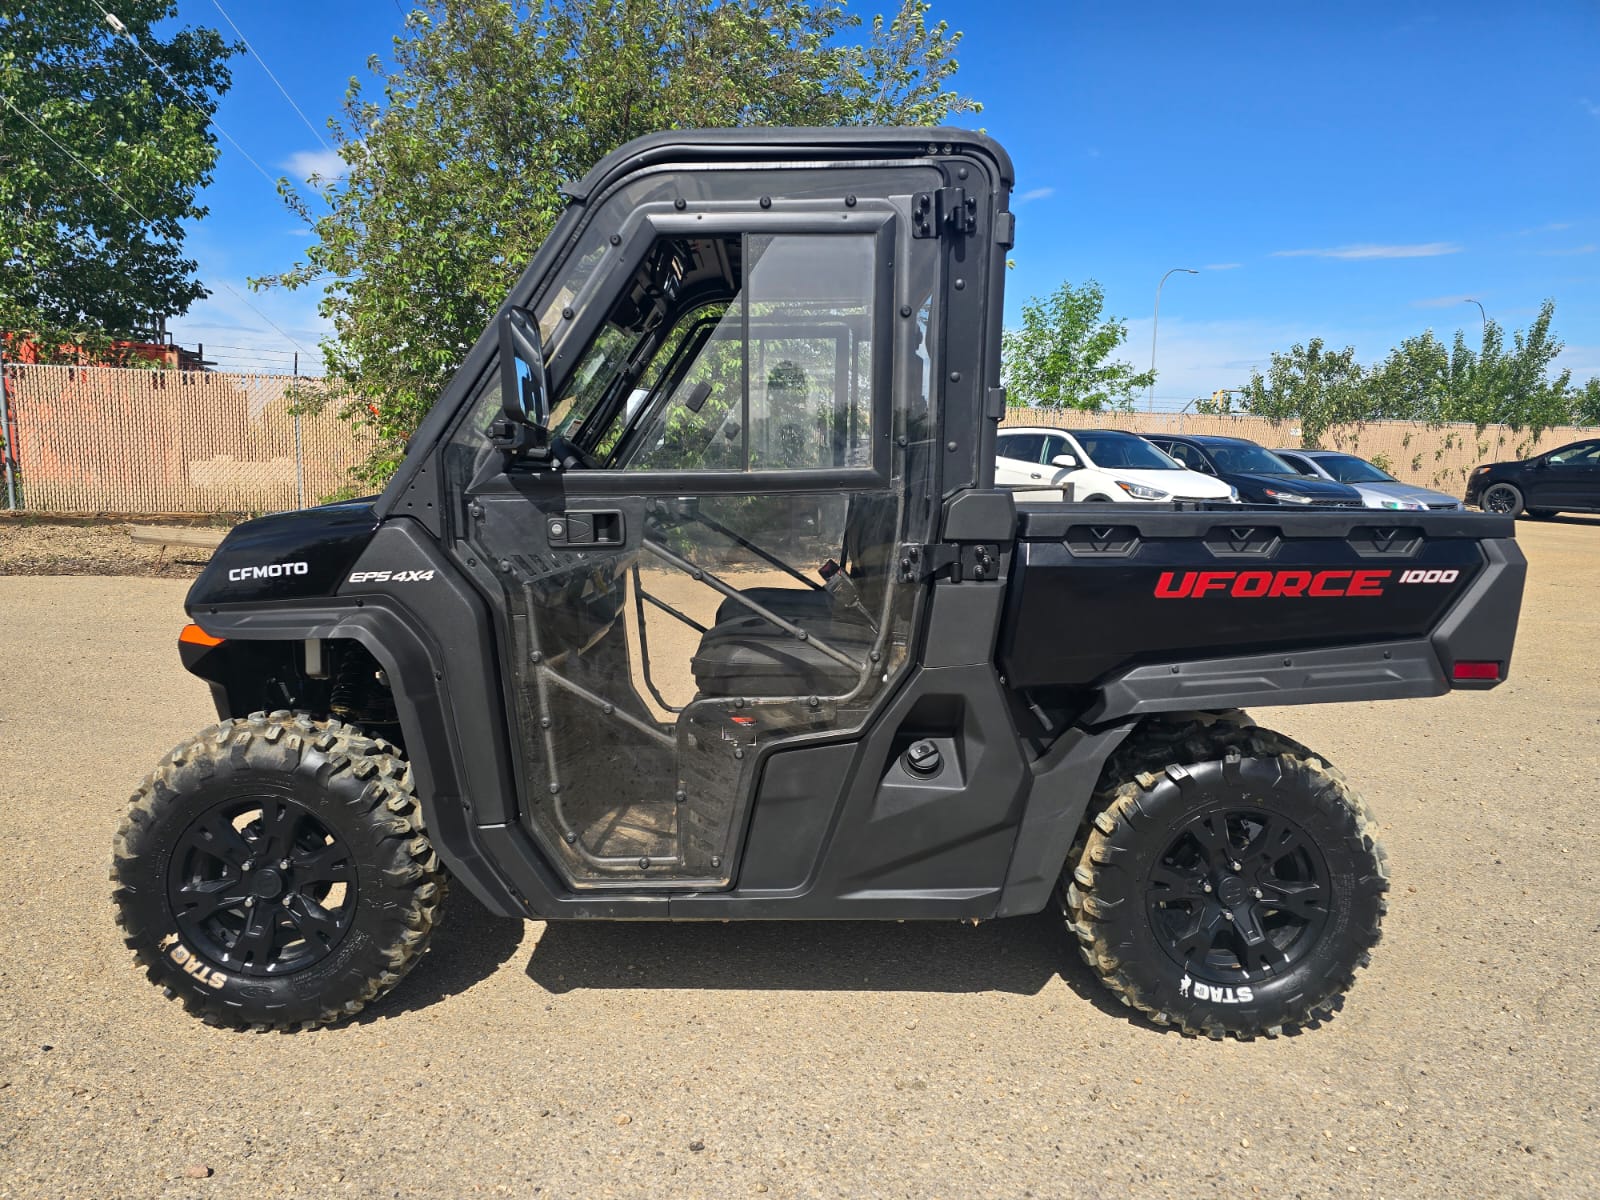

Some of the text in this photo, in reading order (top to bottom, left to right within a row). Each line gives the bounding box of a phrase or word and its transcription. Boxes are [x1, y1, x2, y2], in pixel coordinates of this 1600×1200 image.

[228, 561, 309, 582] CFMOTO
[348, 569, 435, 583] EPS 4X4
[1153, 569, 1460, 599] UFORCE 1000
